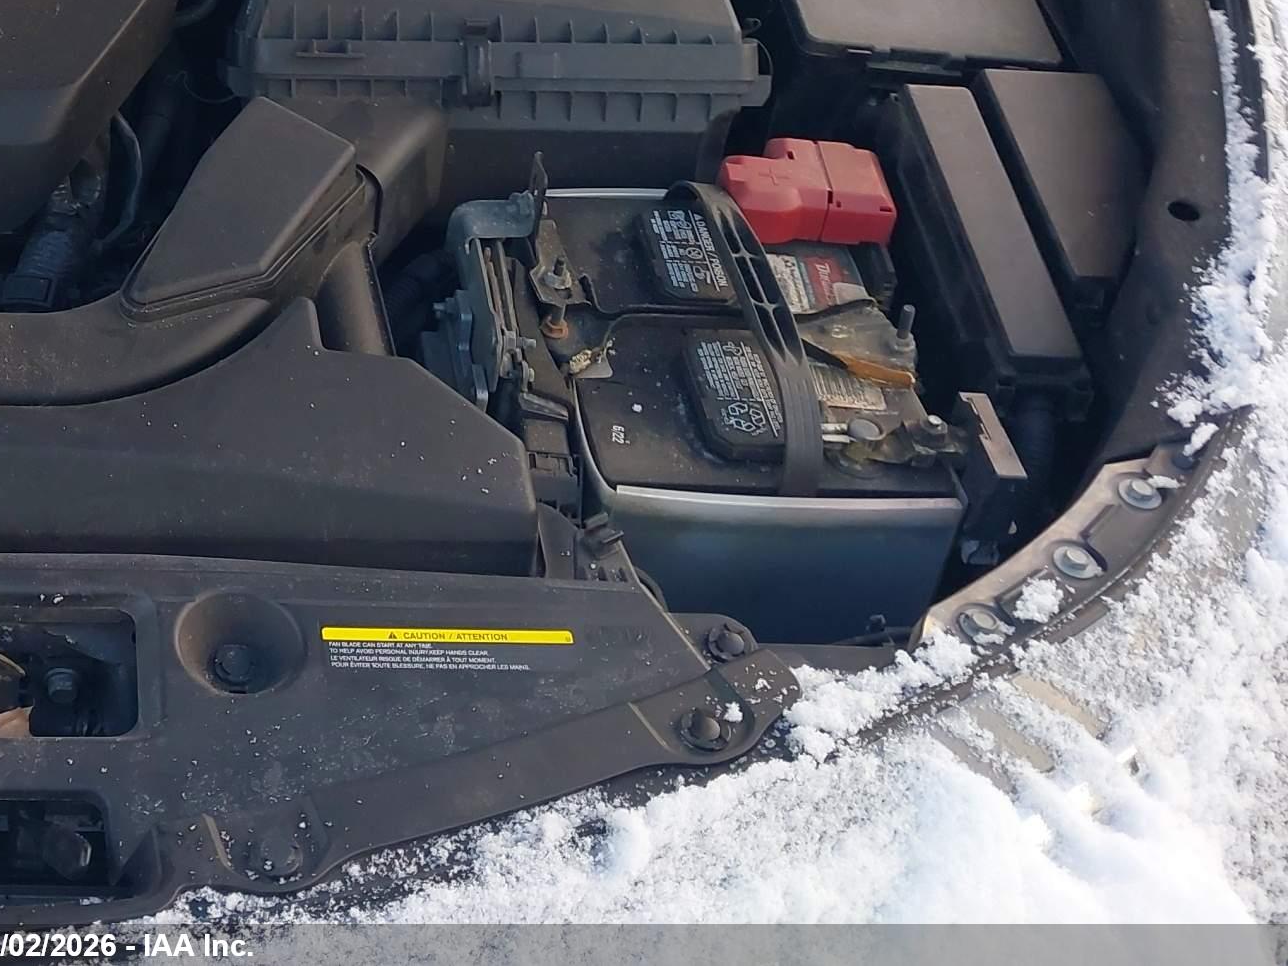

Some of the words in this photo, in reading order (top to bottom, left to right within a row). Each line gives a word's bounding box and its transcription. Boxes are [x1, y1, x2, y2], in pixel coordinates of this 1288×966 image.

[696, 221, 716, 252] DANGER
[710, 258, 729, 287] POISON
[403, 632, 446, 640] CAUTION
[455, 632, 509, 641] ATTENTION
